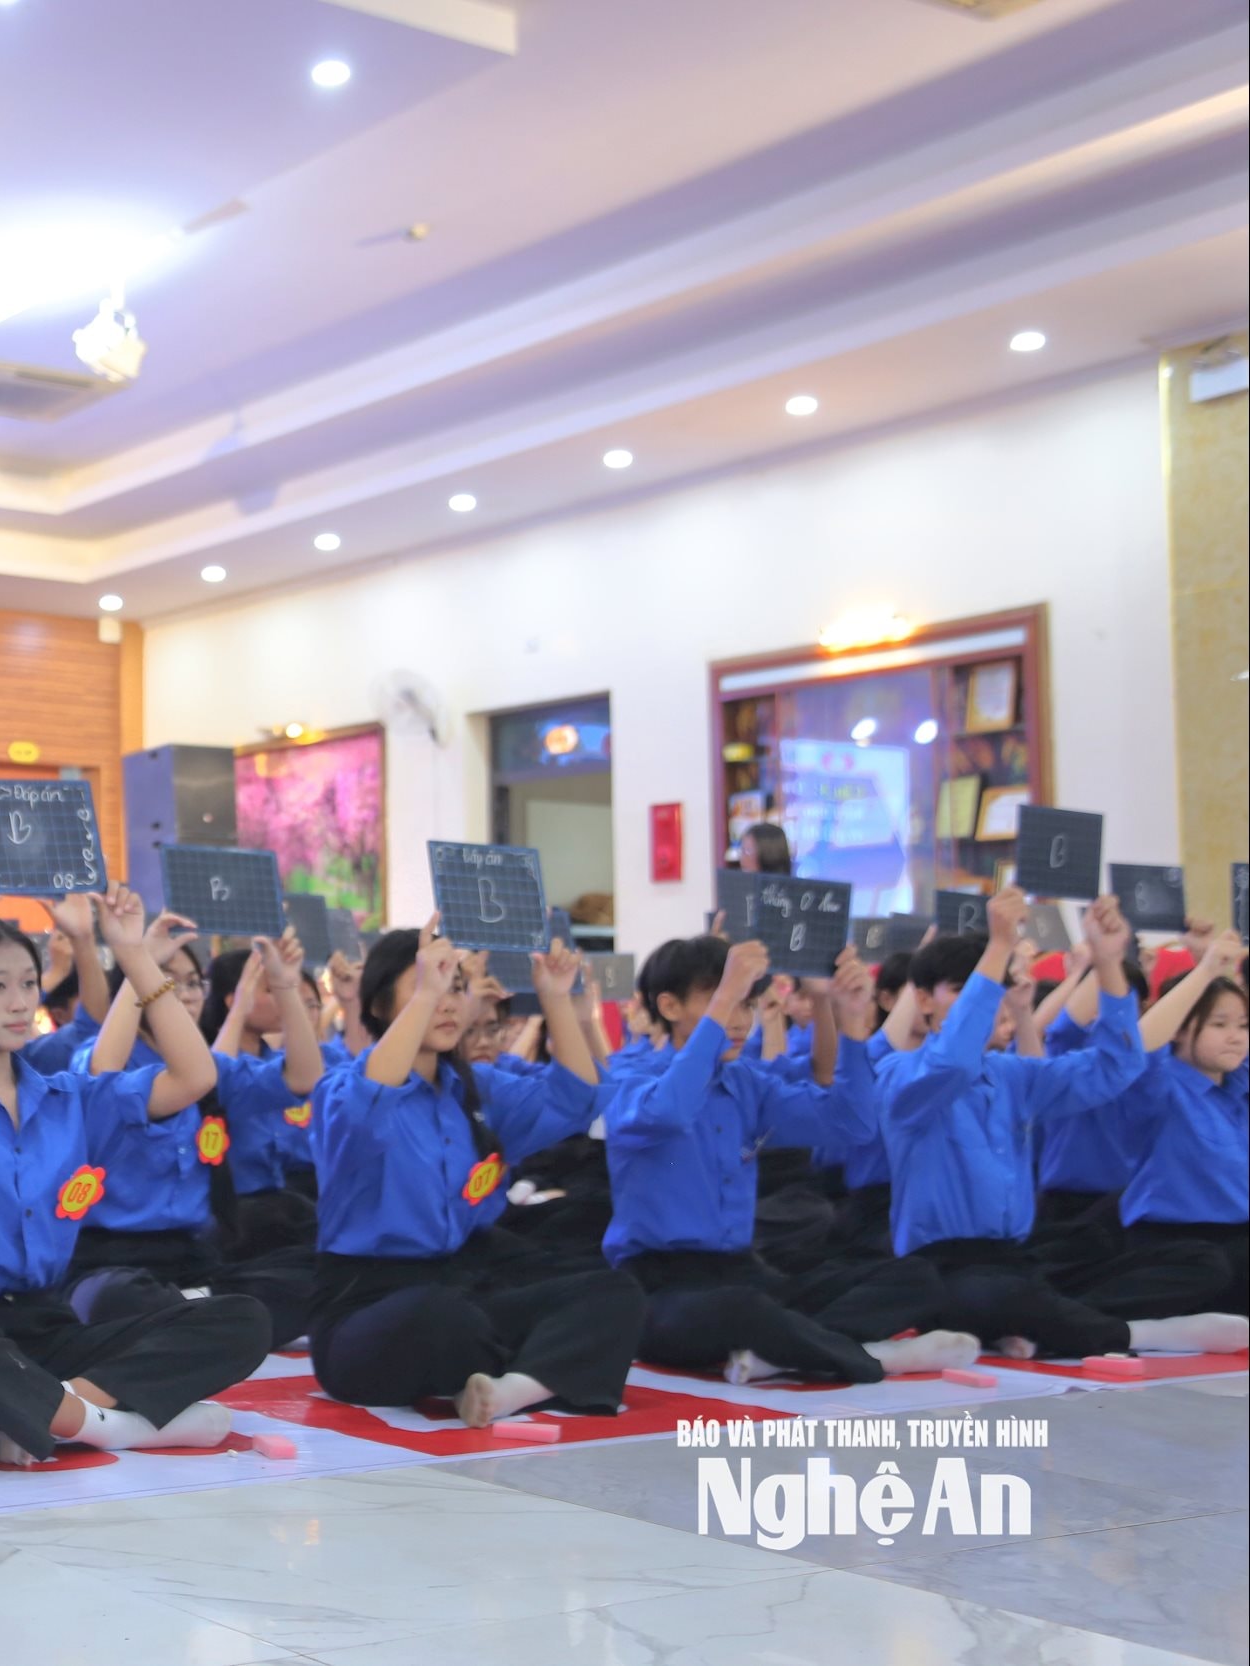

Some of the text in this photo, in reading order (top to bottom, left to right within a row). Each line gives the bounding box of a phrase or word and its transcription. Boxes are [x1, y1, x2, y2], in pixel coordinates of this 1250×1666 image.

[7, 811, 31, 844] B
[478, 878, 505, 923] B
[790, 923, 806, 951] B
[204, 1131, 219, 1150] 17
[67, 1181, 92, 1203] 08
